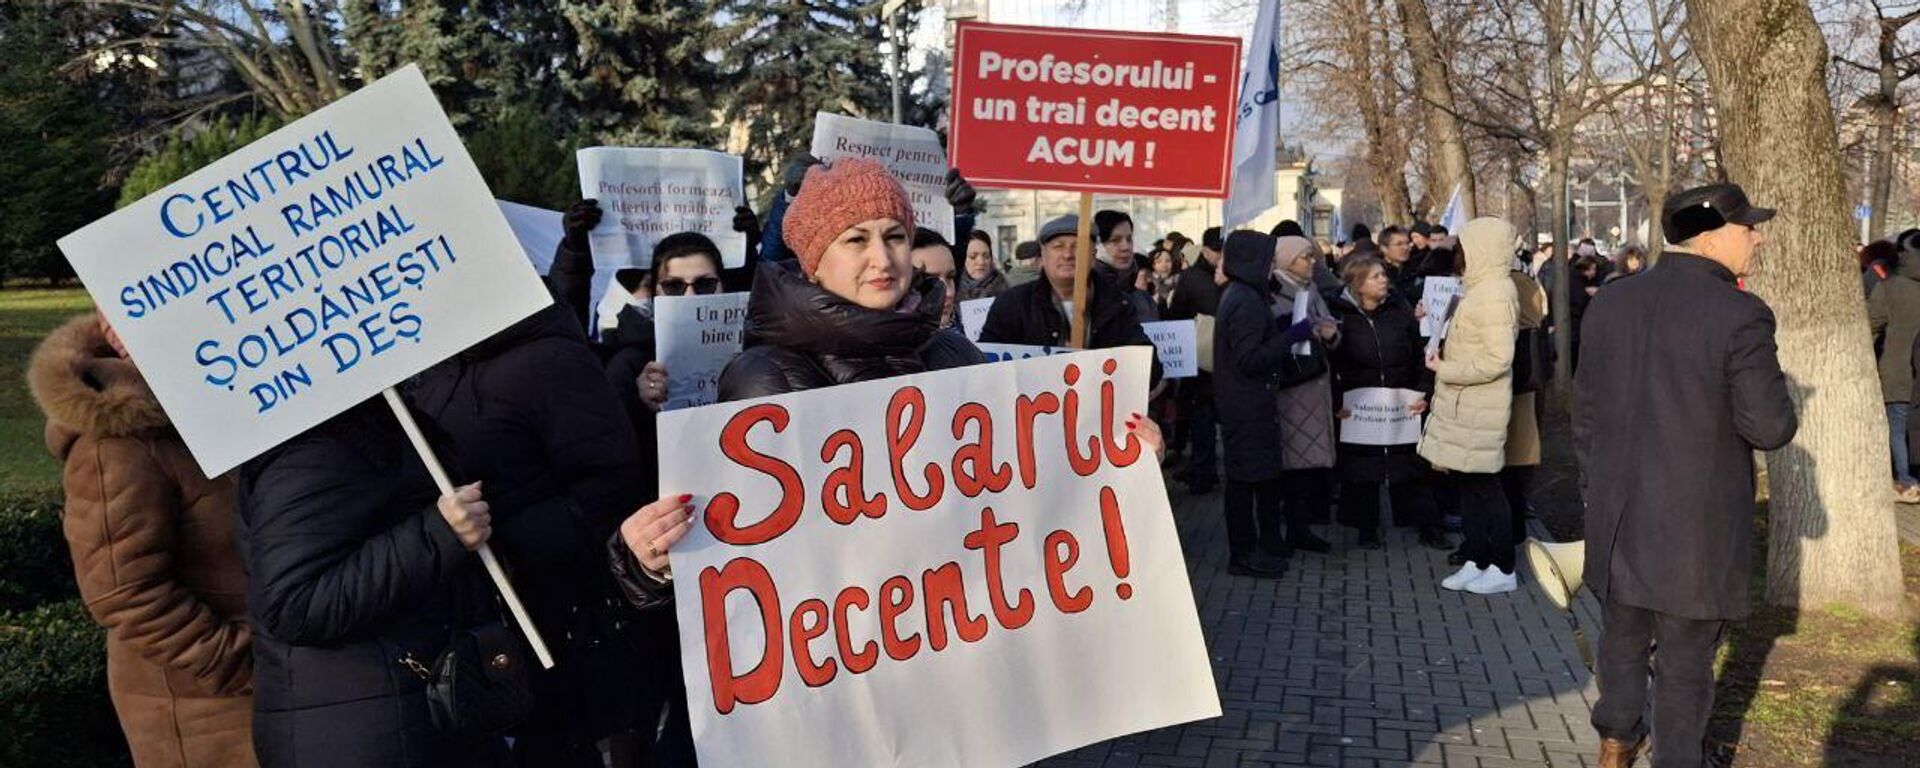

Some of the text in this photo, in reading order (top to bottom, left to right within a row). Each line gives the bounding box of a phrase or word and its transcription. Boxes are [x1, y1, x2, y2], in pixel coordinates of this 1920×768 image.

[977, 51, 1194, 90] Profesorului
[973, 97, 1016, 121] un
[1026, 96, 1085, 125] trai
[1095, 99, 1216, 131] decent
[836, 136, 941, 164] Respect pentru
[1027, 135, 1135, 167] ACUM
[160, 130, 354, 239] CENTRUL
[599, 180, 662, 195] Profesorii
[120, 137, 445, 318] SINDICAL RAMURAL
[696, 306, 719, 322] Un
[701, 328, 734, 345] bine
[249, 301, 423, 414] DIN DEȘ
[704, 358, 1142, 546] Salarii
[699, 486, 1133, 715] Decente!
